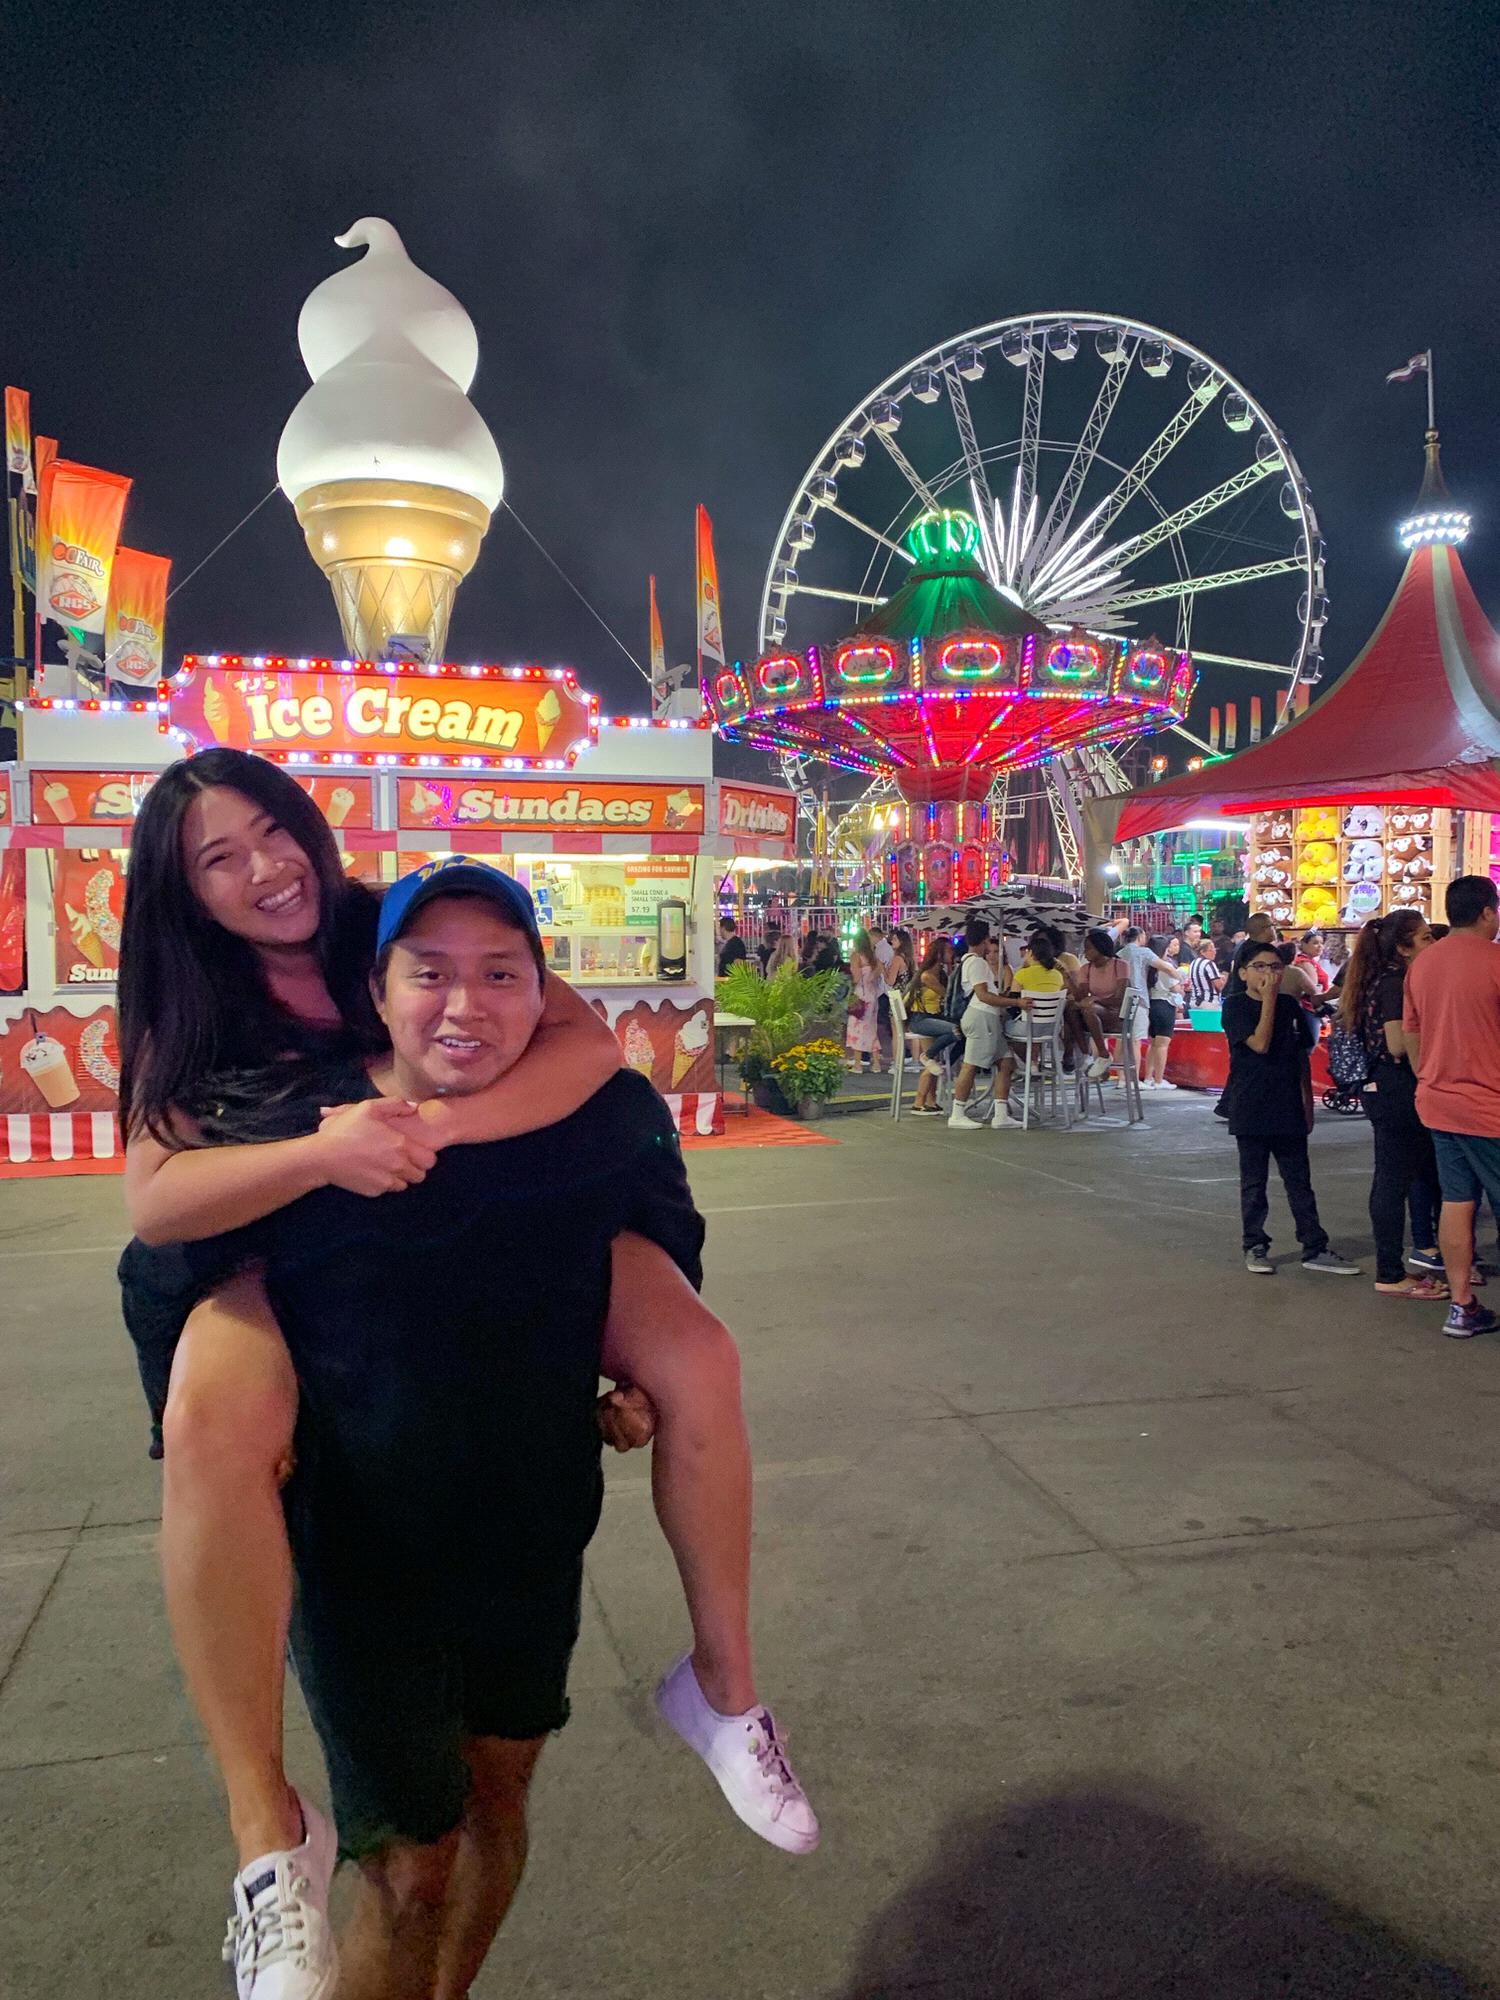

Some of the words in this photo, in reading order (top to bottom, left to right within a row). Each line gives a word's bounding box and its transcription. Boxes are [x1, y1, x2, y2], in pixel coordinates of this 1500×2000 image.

[233, 676, 277, 692] TJ's
[245, 694, 333, 742] Ice
[346, 686, 524, 750] Cream
[458, 789, 653, 824] Sundaes
[723, 797, 789, 833] Drinks
